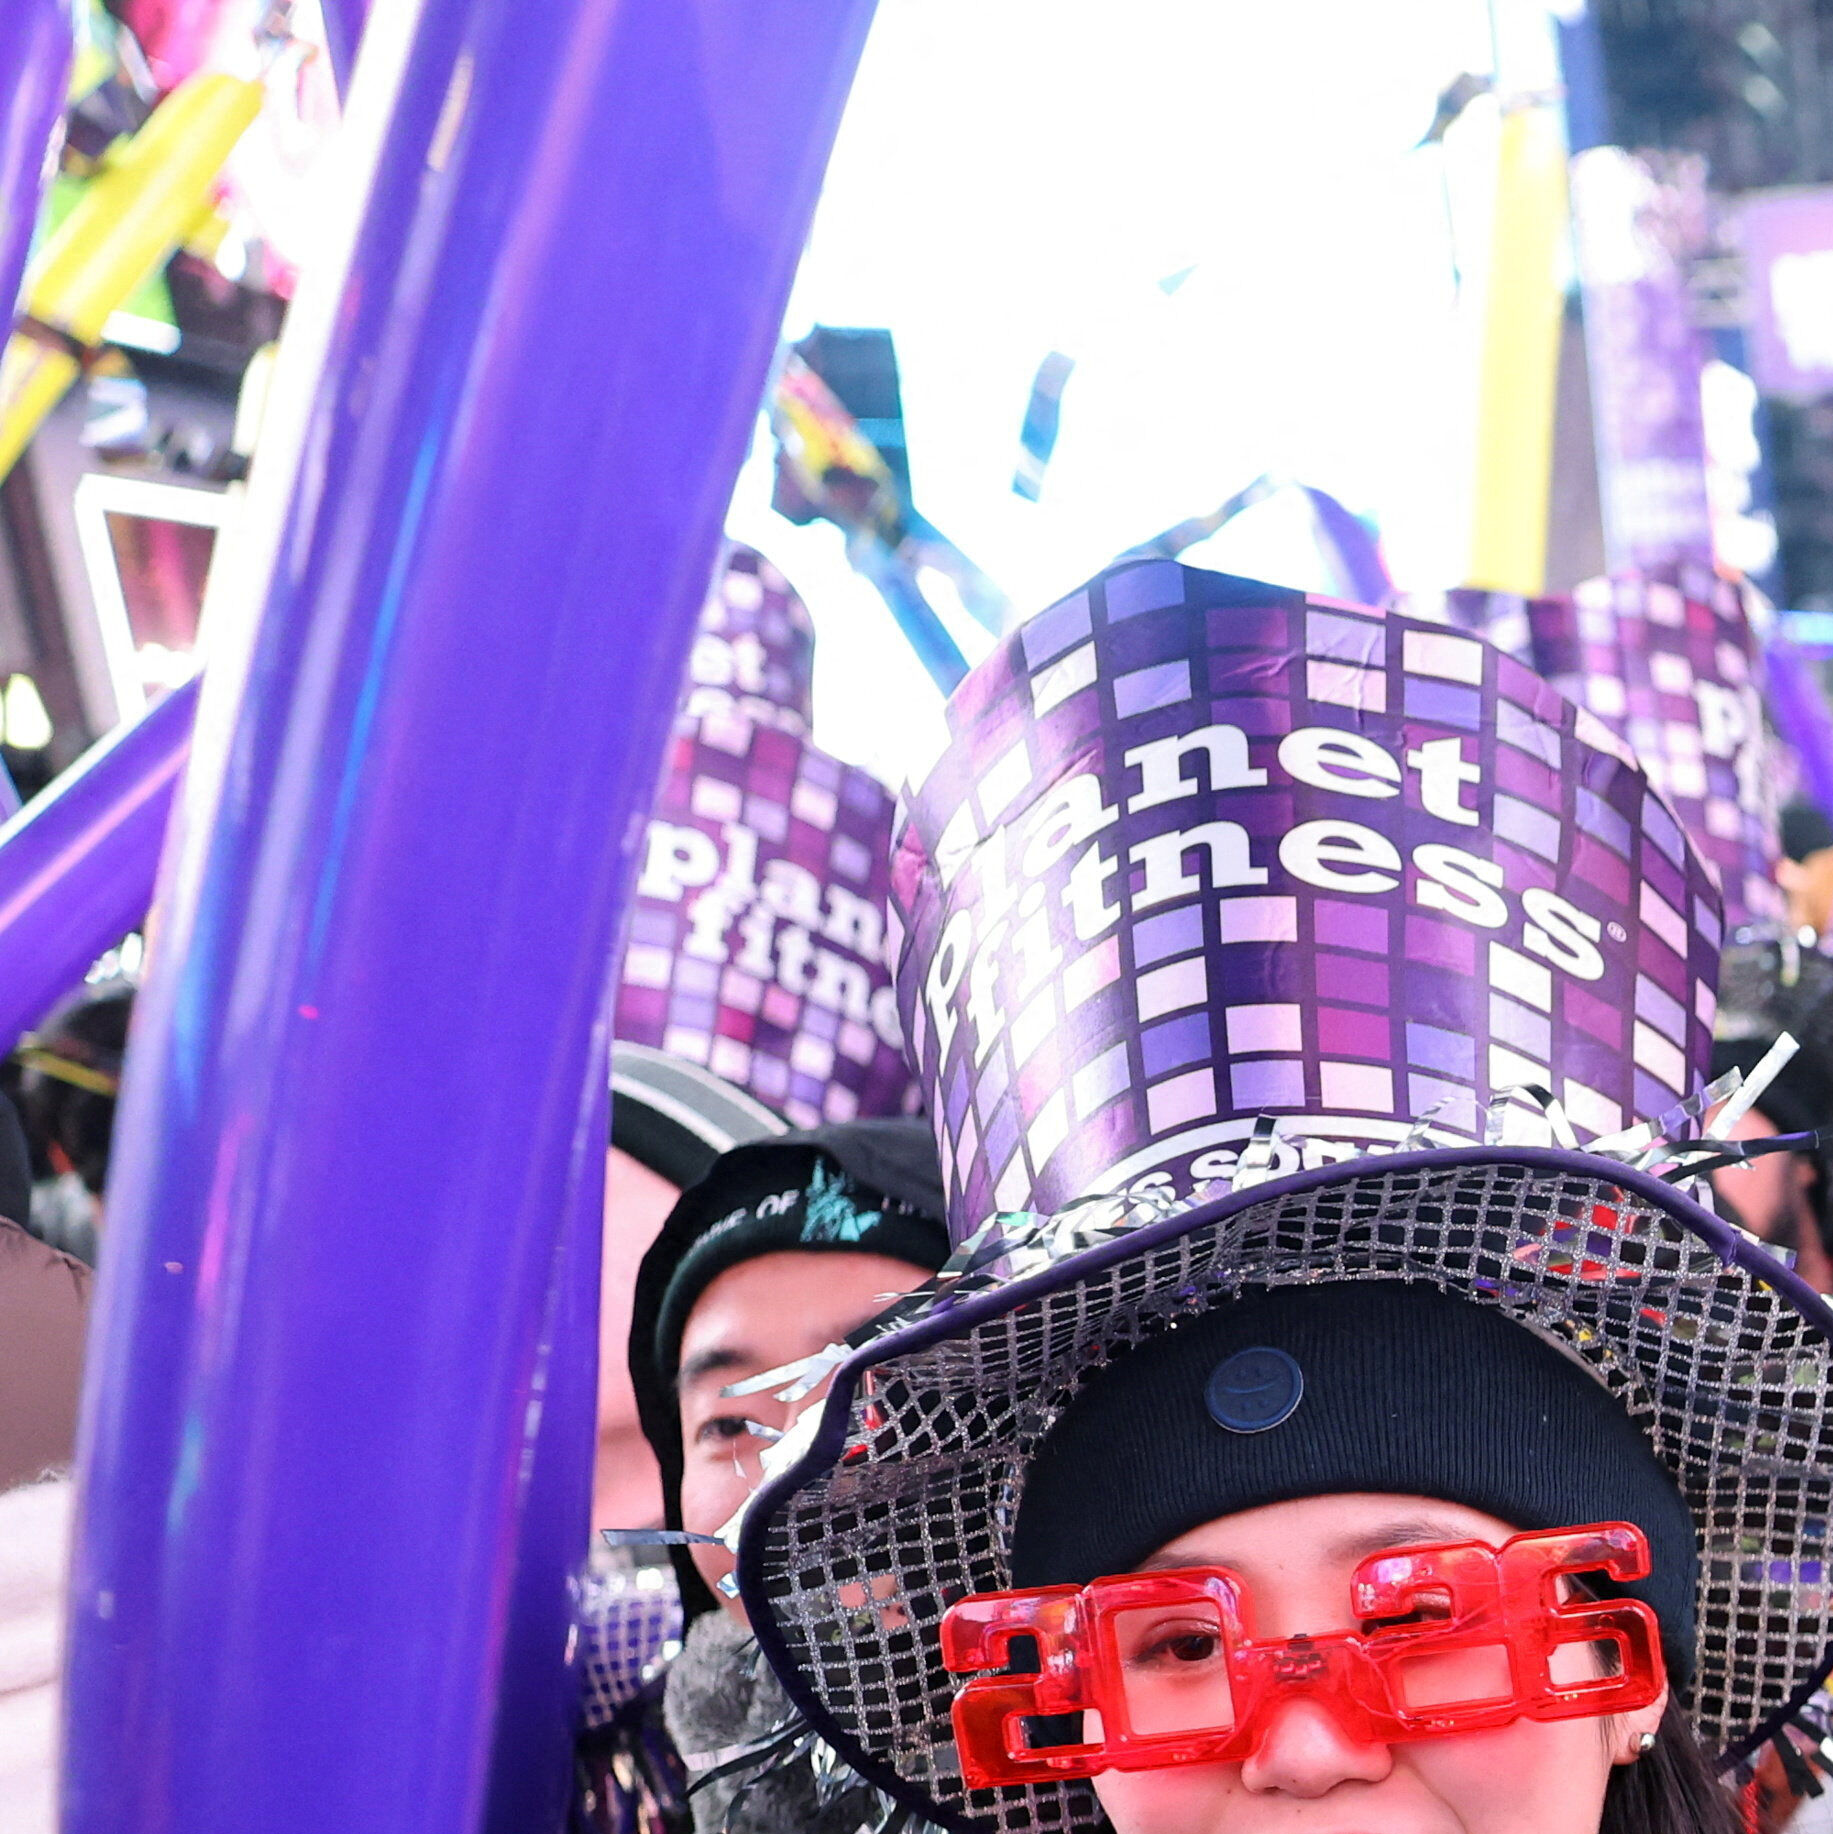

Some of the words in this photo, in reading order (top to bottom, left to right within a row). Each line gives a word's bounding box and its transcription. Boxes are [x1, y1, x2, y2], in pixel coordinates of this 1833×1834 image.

[637, 818, 893, 968] plan
[926, 723, 1480, 1078] planet
[965, 818, 1605, 1070] fitness
